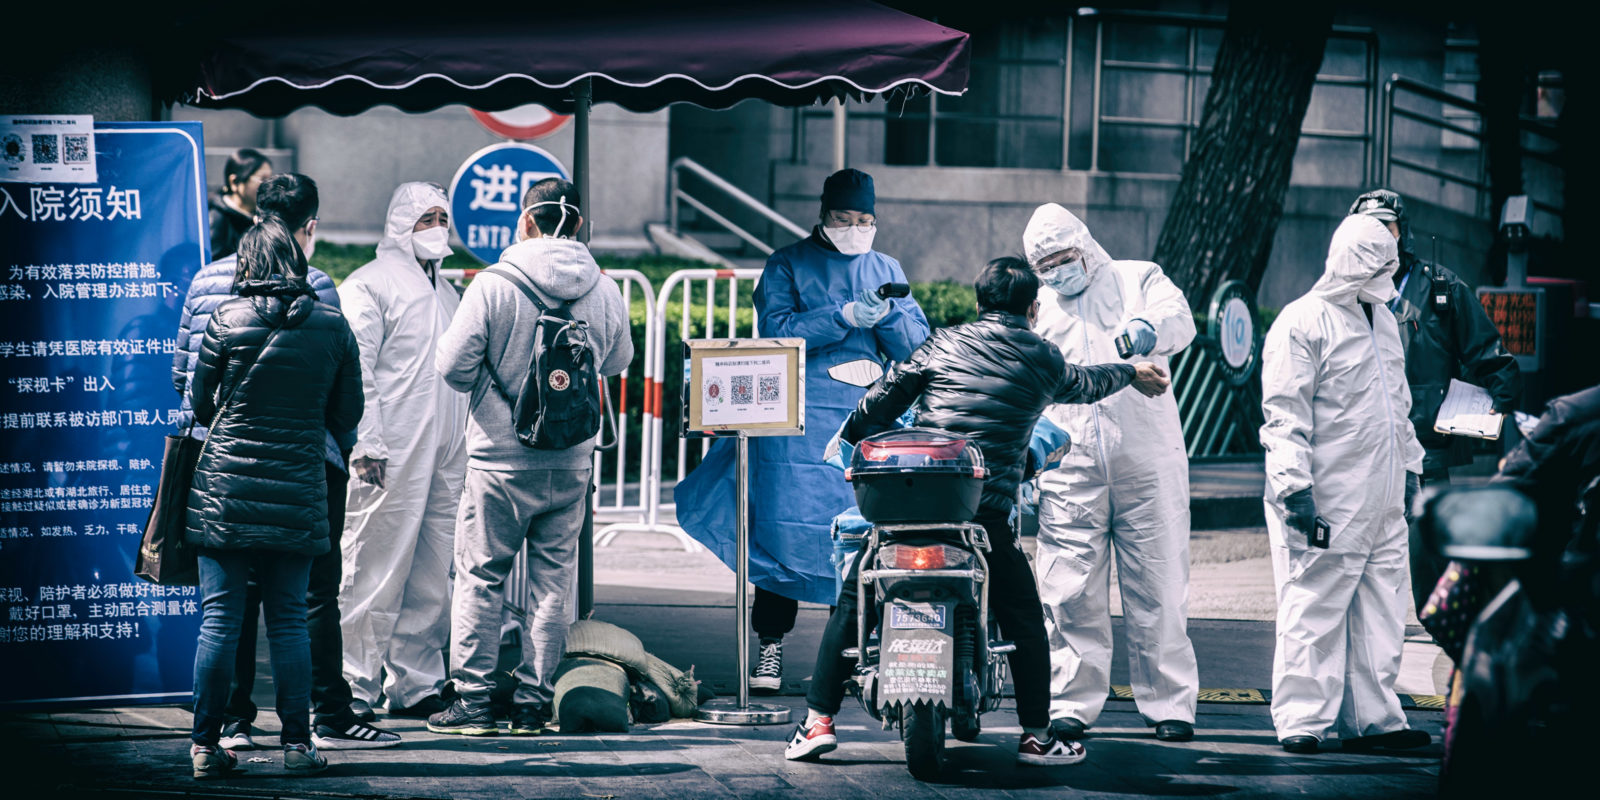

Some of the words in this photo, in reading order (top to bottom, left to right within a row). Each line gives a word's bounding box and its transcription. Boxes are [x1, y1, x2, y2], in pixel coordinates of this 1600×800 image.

[0, 185, 142, 222] 入院须知
[468, 224, 518, 249] ENTR
[0, 408, 180, 429] 提前联系被访部门或人员
